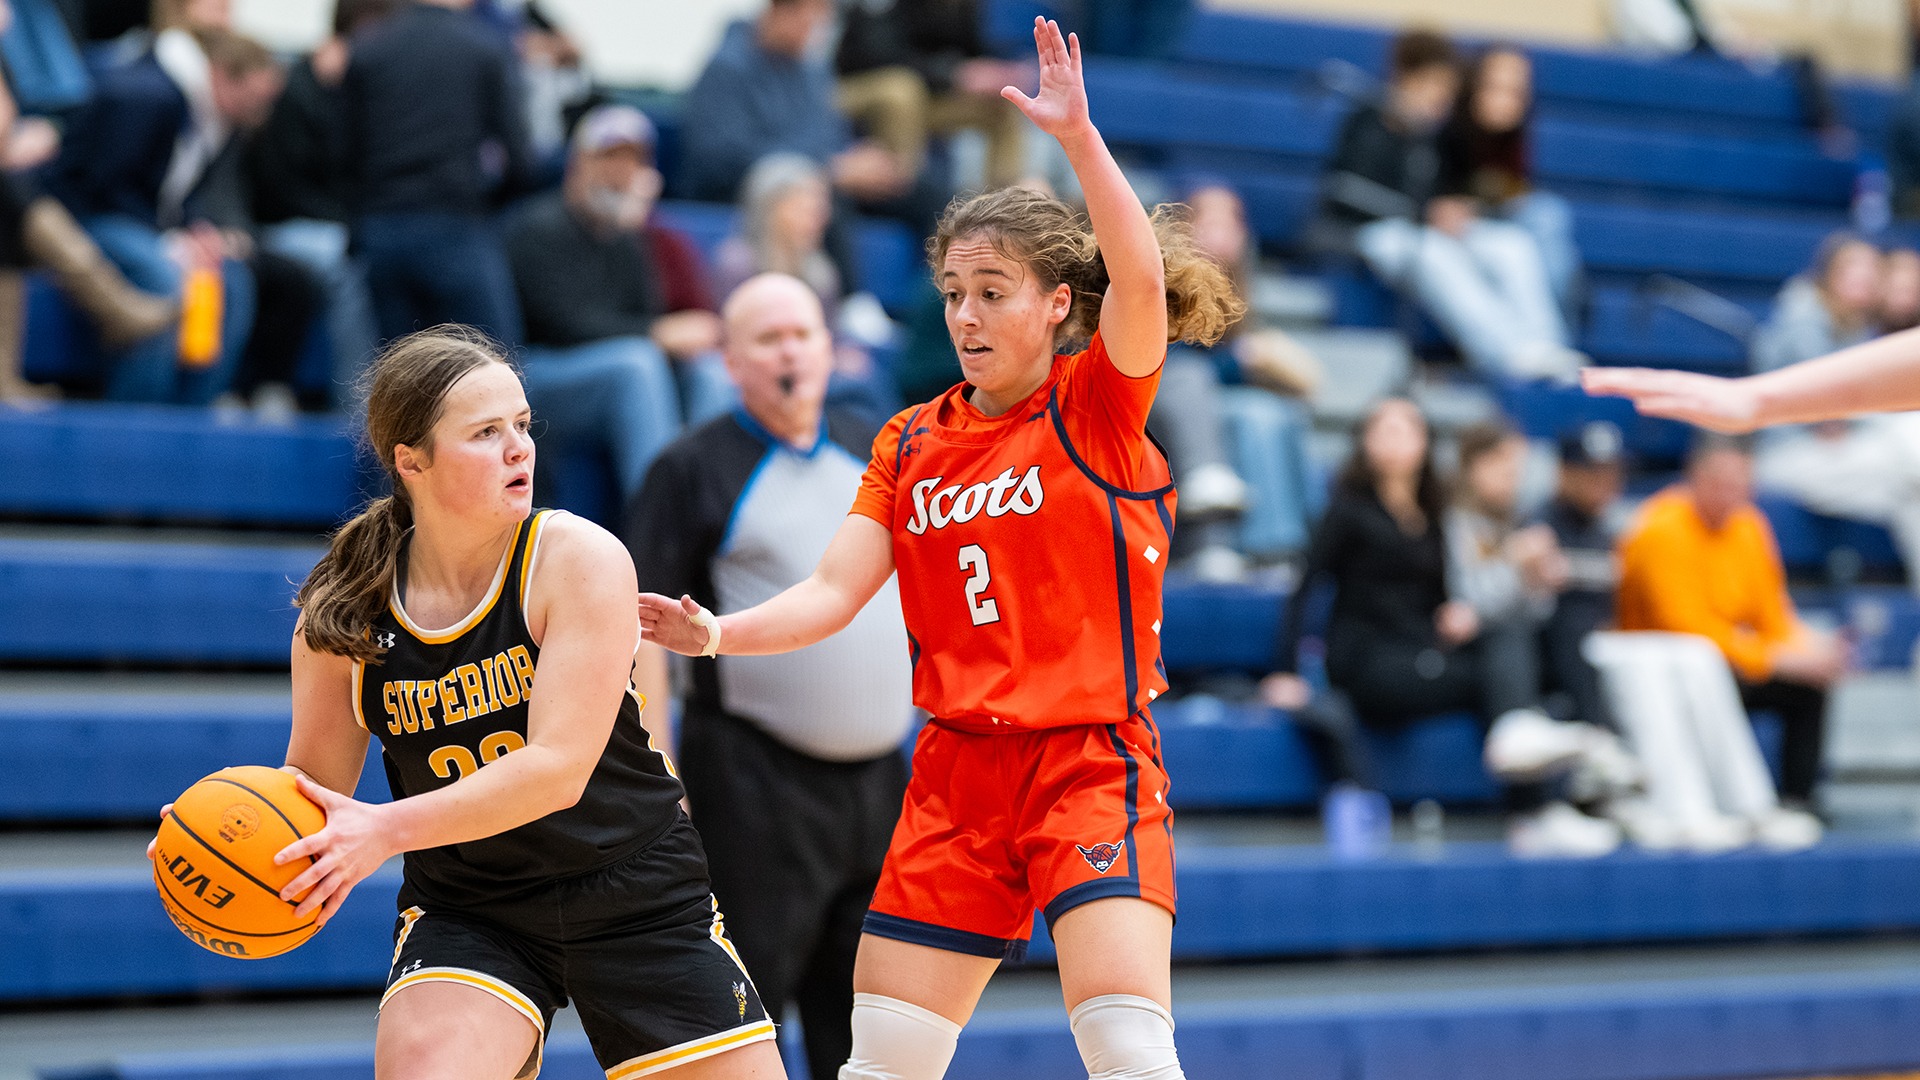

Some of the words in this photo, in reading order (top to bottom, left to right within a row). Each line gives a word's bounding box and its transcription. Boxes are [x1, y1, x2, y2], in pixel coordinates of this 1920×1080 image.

[906, 465, 1045, 536] Scots
[958, 543, 1001, 627] 2
[383, 644, 535, 735] SUPERIOR
[168, 855, 236, 909] EVO
[158, 893, 250, 956] Wils
